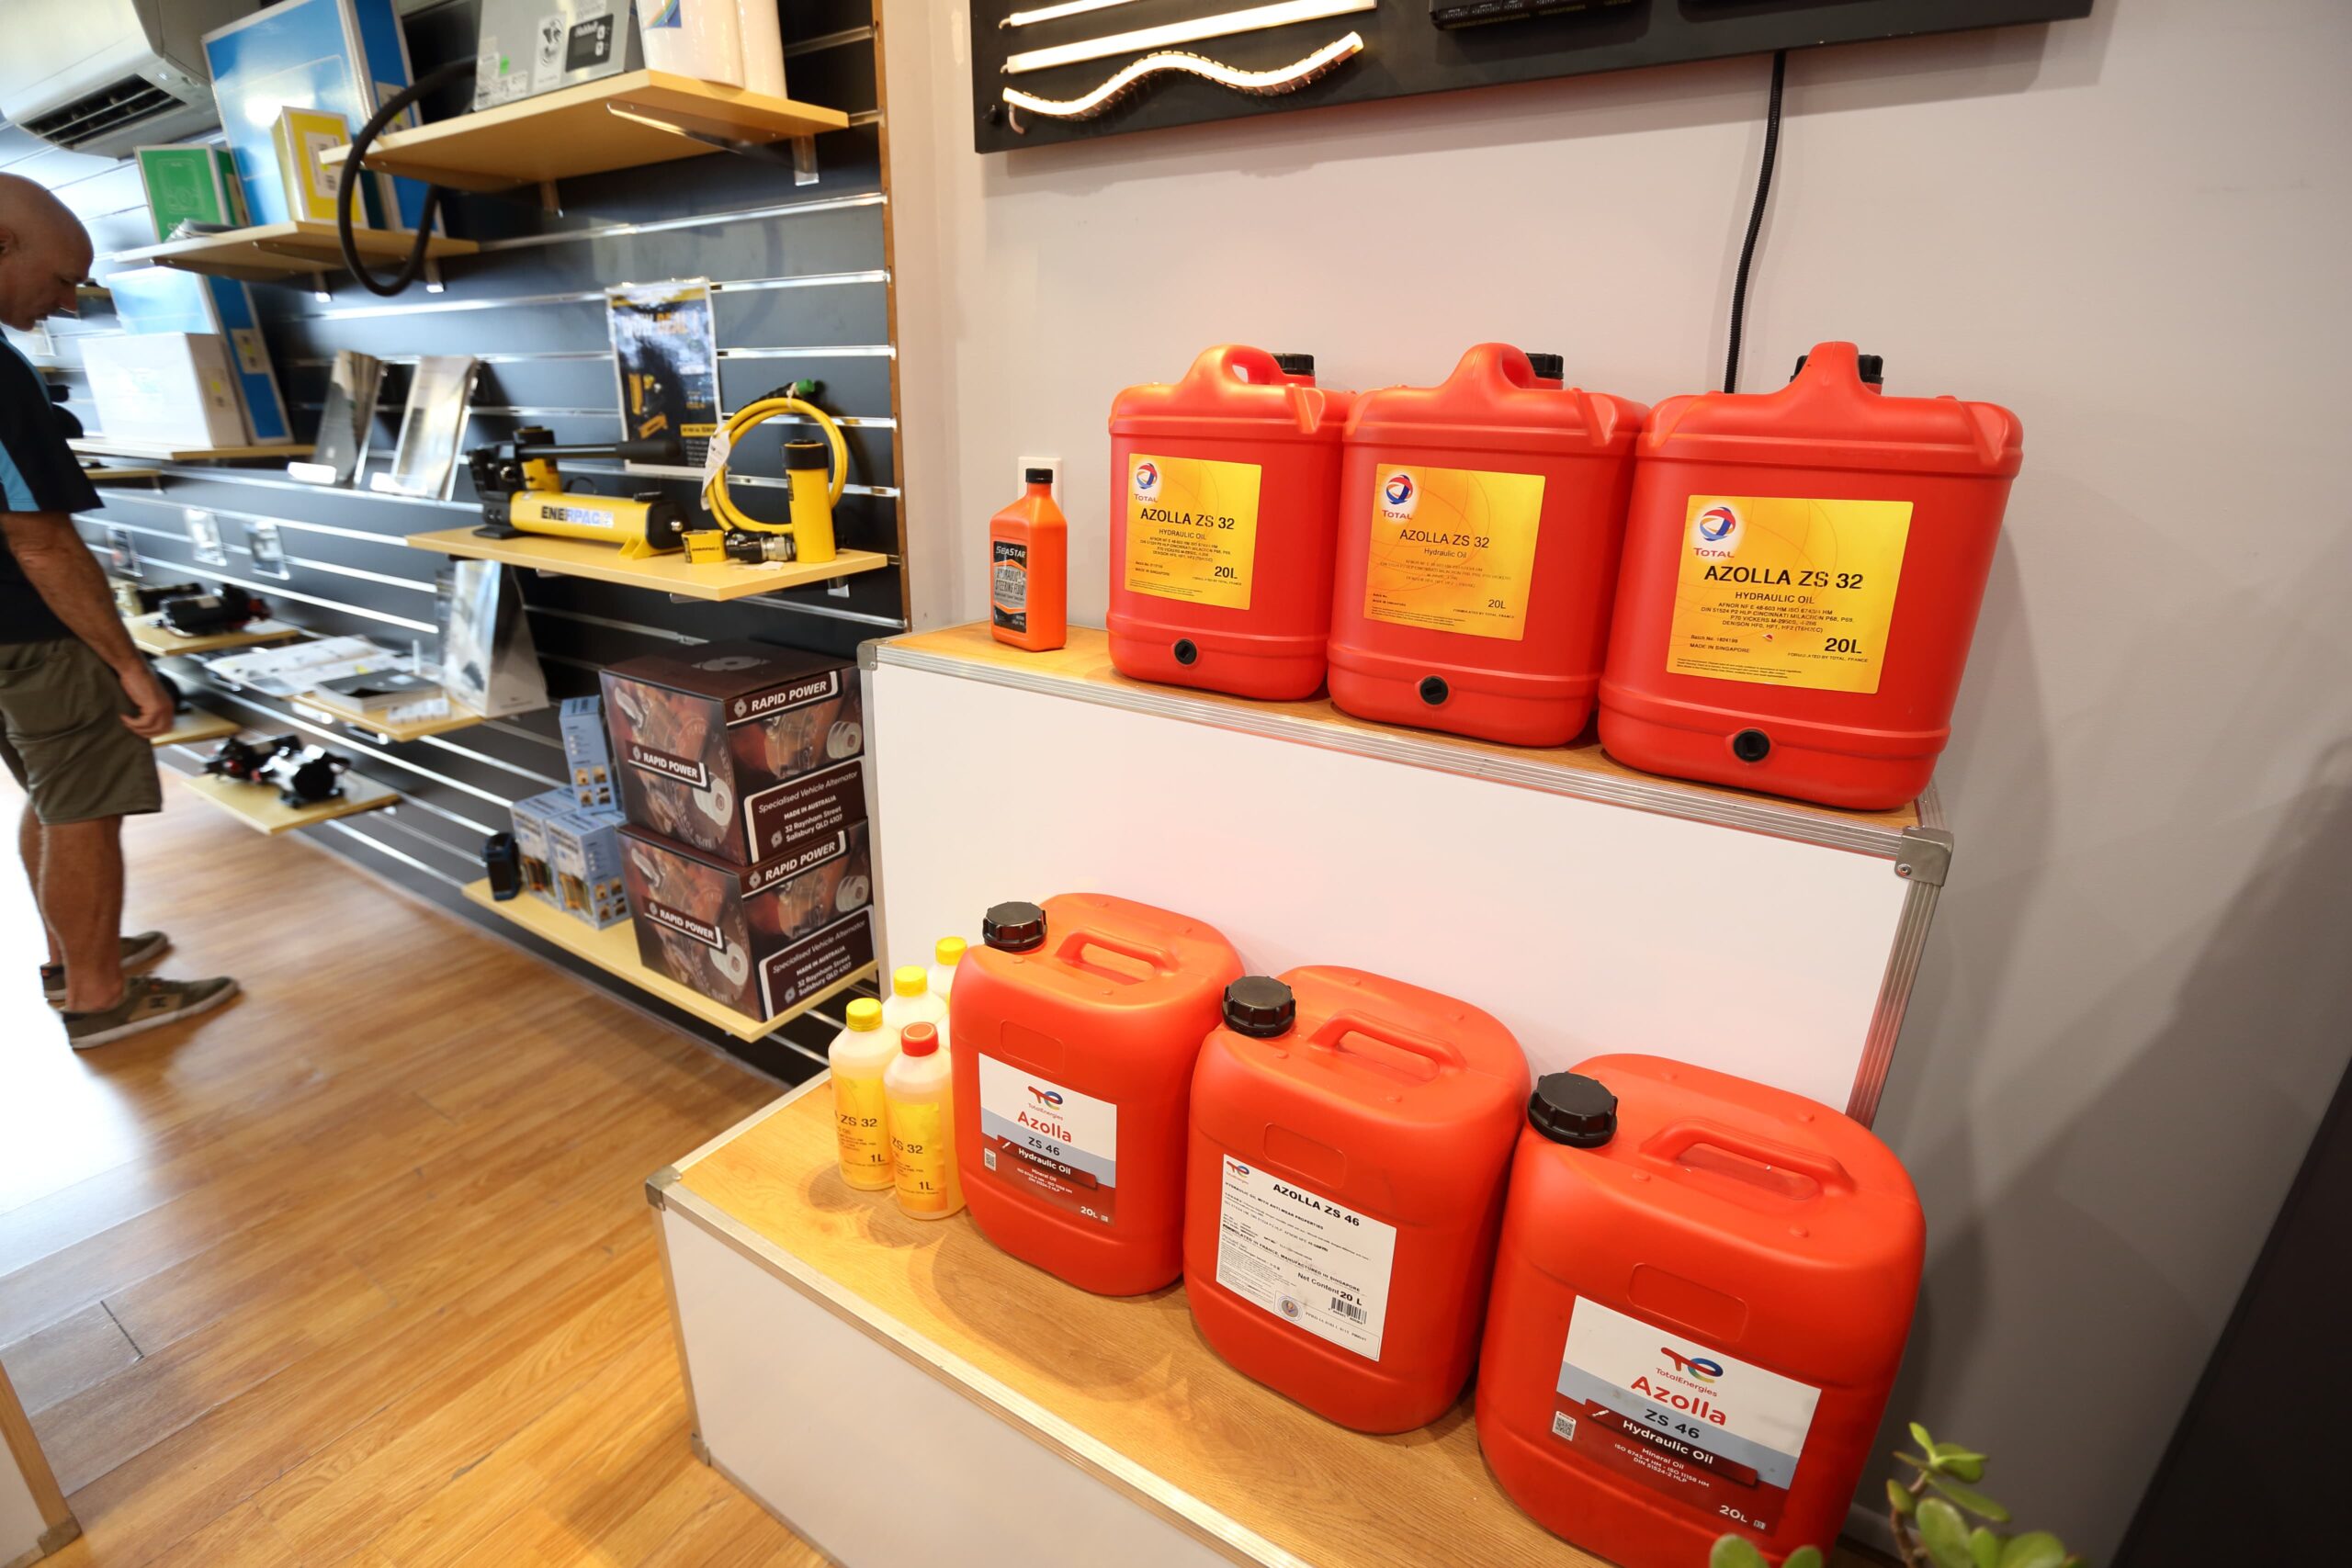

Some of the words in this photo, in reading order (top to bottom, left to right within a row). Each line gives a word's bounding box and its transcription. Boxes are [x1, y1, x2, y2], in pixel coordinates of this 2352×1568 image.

[1134, 494, 1158, 502] TOTAL
[542, 506, 599, 524] ENERPAC
[1140, 508, 1191, 525] AZOLLA
[1195, 514, 1214, 527] ZS
[1218, 517, 1235, 529] 32
[1382, 510, 1412, 520] TOTAL
[1159, 529, 1194, 538] HYDRAULIC
[1399, 529, 1448, 544] AZOLLA
[1453, 535, 1469, 546] ZS
[1474, 536, 1489, 548] 32
[1424, 548, 1455, 558] Hydraulic
[1694, 547, 1735, 558] TOTAL
[1215, 566, 1238, 579] 20L
[1704, 566, 1791, 585] AZOLLA
[1798, 571, 1828, 587] ZS
[1836, 573, 1863, 589] 32
[1488, 599, 1506, 609] 20L
[1736, 592, 1795, 603] HYDRAULIC
[1824, 638, 1862, 654] 20L
[752, 692, 786, 711] RAPID
[788, 681, 827, 702] POWER
[643, 752, 668, 769] RAPID
[669, 760, 698, 778] POWER
[758, 791, 799, 814] Specialised
[801, 781, 824, 797] Vehicle
[826, 771, 857, 788] Alternator
[784, 808, 800, 819] MADE
[808, 795, 836, 811] AUSTRALIA
[785, 825, 793, 833] 32
[794, 814, 822, 832] Raynham
[823, 807, 842, 819] Street
[786, 823, 814, 842] Salisbury
[815, 820, 829, 831] QLD
[829, 814, 842, 826] 4107
[765, 858, 797, 881] RAPID
[800, 841, 835, 866] POWER
[660, 910, 683, 926] RAPID
[685, 920, 714, 940] POWER
[773, 948, 812, 974] Specialised
[812, 936, 834, 953] Vehicle
[835, 920, 865, 940] Alternator
[797, 964, 811, 976] MADE
[819, 945, 845, 964] AUSTRALIA
[797, 977, 805, 987] 32
[833, 955, 851, 969] Street
[798, 976, 826, 997] Salisbury
[841, 1114, 857, 1126] ZS
[861, 1119, 877, 1127] 32
[1017, 1111, 1071, 1143] Azolla
[891, 1135, 903, 1151] ZS
[907, 1145, 923, 1154] 32
[1028, 1136, 1042, 1149] ZS
[1046, 1143, 1060, 1156] 46
[1018, 1148, 1057, 1169] Hydraulic
[1058, 1165, 1071, 1175] Oil
[1080, 1206, 1098, 1218] 20L
[1273, 1184, 1320, 1210] AZOLLA
[1325, 1205, 1340, 1218] ZS
[1344, 1215, 1360, 1226] 46
[1297, 1273, 1309, 1281] Net
[1312, 1278, 1340, 1294] Content
[1340, 1292, 1352, 1302] 20
[1330, 1276, 1360, 1292] SINGAPORE
[1656, 1368, 1717, 1396] TotalEnergies
[1631, 1375, 1726, 1426] Azolla
[1645, 1408, 1668, 1427] ZS
[1674, 1422, 1700, 1438] 46
[1623, 1420, 1689, 1454] Hydraulic
[1692, 1450, 1713, 1464] Oil
[1614, 1443, 1626, 1451] ISO
[1627, 1449, 1649, 1462] 6743-4
[1668, 1467, 1679, 1475] ISO
[1634, 1457, 1645, 1465] DIN
[1642, 1448, 1670, 1464] Mineral
[1672, 1461, 1684, 1470] Oil
[1718, 1505, 1747, 1523] 20L
